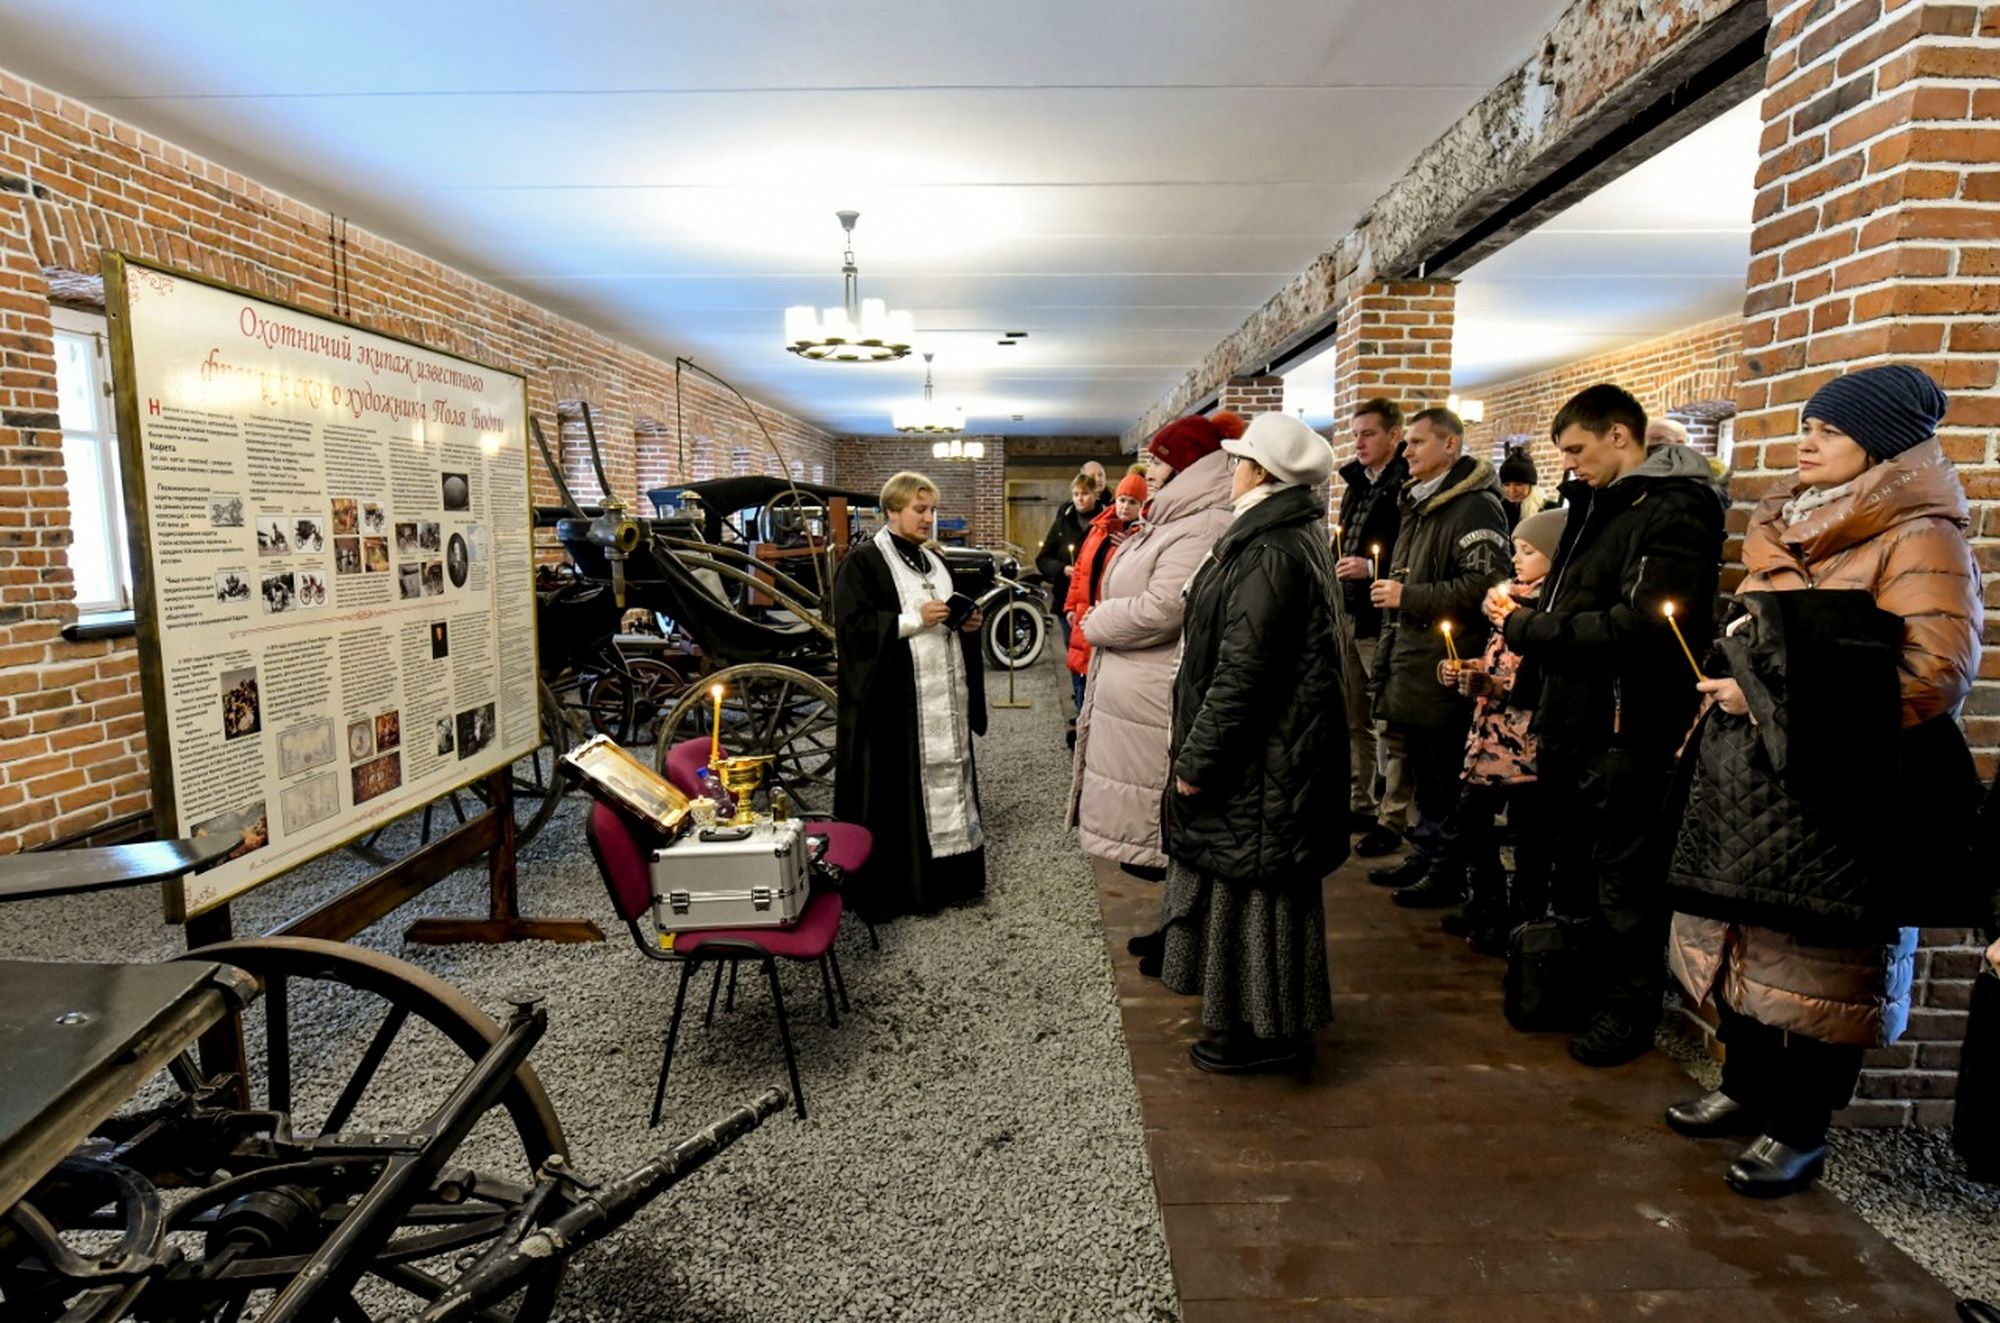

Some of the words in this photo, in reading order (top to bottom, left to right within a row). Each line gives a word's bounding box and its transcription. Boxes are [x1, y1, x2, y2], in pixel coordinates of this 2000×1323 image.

[240, 306, 352, 362] Охотничий
[357, 346, 418, 383] экипаж
[417, 361, 484, 393] известного
[346, 380, 427, 422] художника
[433, 399, 466, 428] Поля
